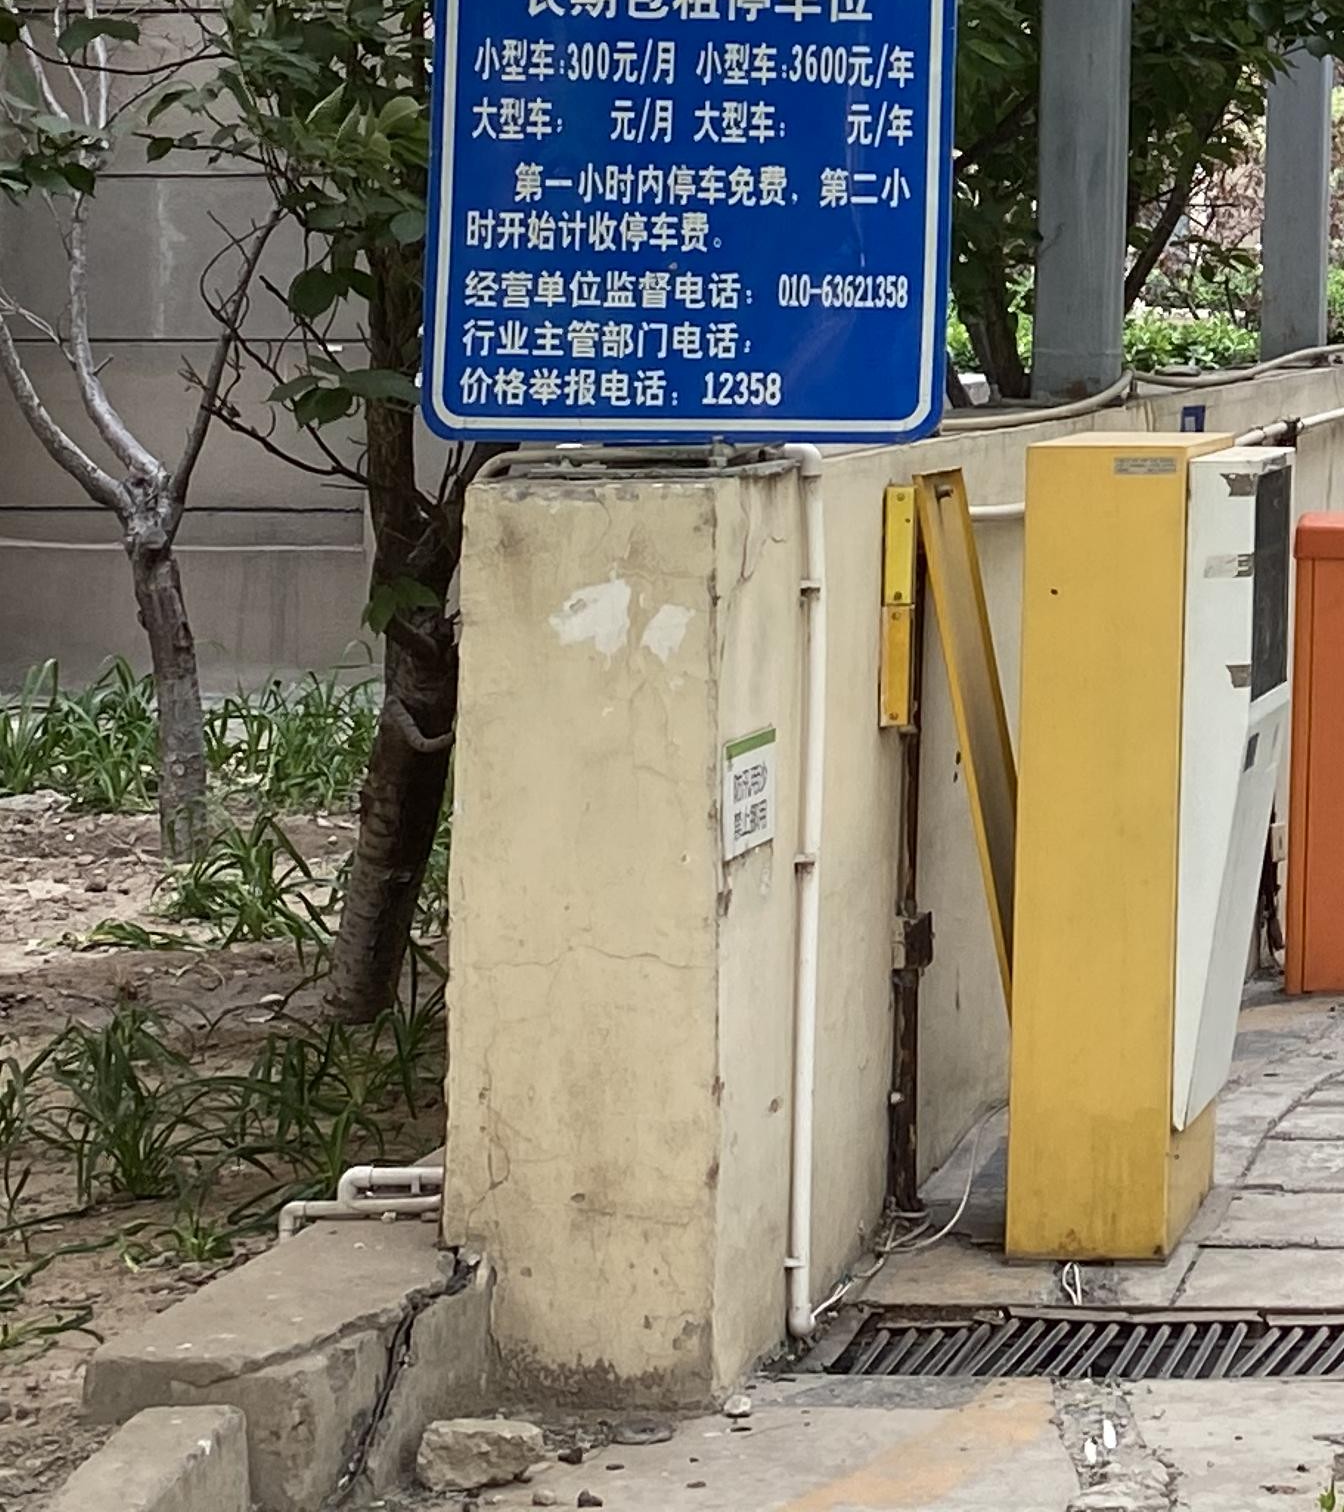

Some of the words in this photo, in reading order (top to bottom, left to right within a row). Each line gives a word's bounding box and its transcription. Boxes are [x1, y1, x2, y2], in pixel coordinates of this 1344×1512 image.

[464, 209, 723, 253] 时开始计收停车费。
[461, 318, 753, 362] 行业主管部门电话：
